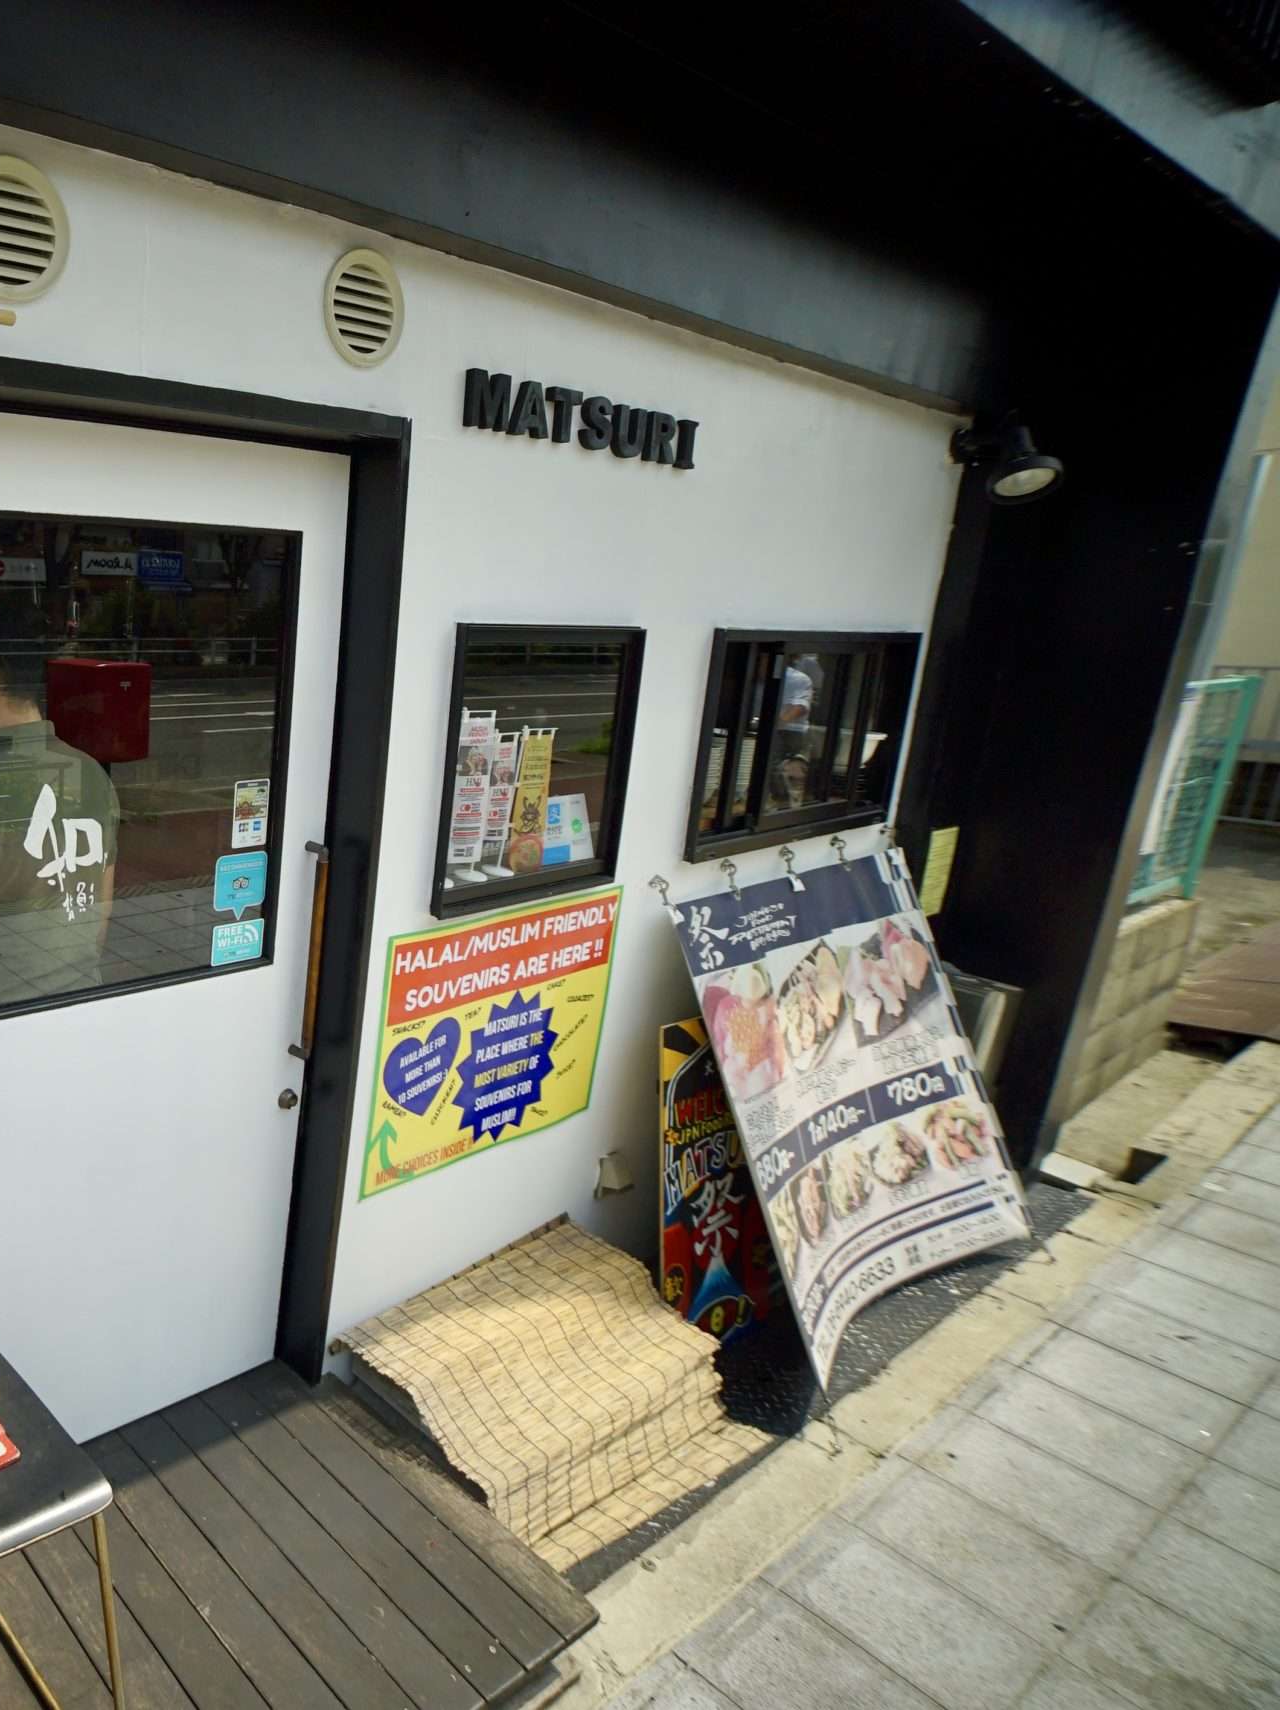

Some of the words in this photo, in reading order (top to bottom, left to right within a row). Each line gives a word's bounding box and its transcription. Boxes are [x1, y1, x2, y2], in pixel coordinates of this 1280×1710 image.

[463, 367, 699, 469] MATSURI
[218, 925, 244, 938] FREE
[395, 921, 540, 976] HALAL/MUSLIM
[542, 901, 617, 939] FRIENDLY
[404, 964, 510, 1012] SOUVENIRS
[513, 956, 548, 981] ARE
[551, 945, 591, 970] HERE
[484, 1015, 519, 1037] MATSURI
[519, 1010, 528, 1024] IS
[528, 1007, 543, 1023] THE
[399, 1042, 434, 1069] AVAILABLE
[434, 1034, 447, 1050] FOR
[476, 1043, 501, 1064] PLACE
[501, 1035, 529, 1056] WHERE
[529, 1030, 545, 1046] THE
[404, 1064, 424, 1084] MORE
[424, 1055, 441, 1072] THAN
[474, 1067, 496, 1089] MOST
[496, 1058, 529, 1083] VARIETY
[529, 1055, 540, 1070] OF
[474, 1085, 517, 1112] SOUVENIRS
[517, 1080, 532, 1097] FOR
[375, 1163, 401, 1186] MORE
[402, 1150, 439, 1175] CHOICES
[440, 1138, 466, 1161] INSIDE
[665, 1130, 744, 1216] MATSU
